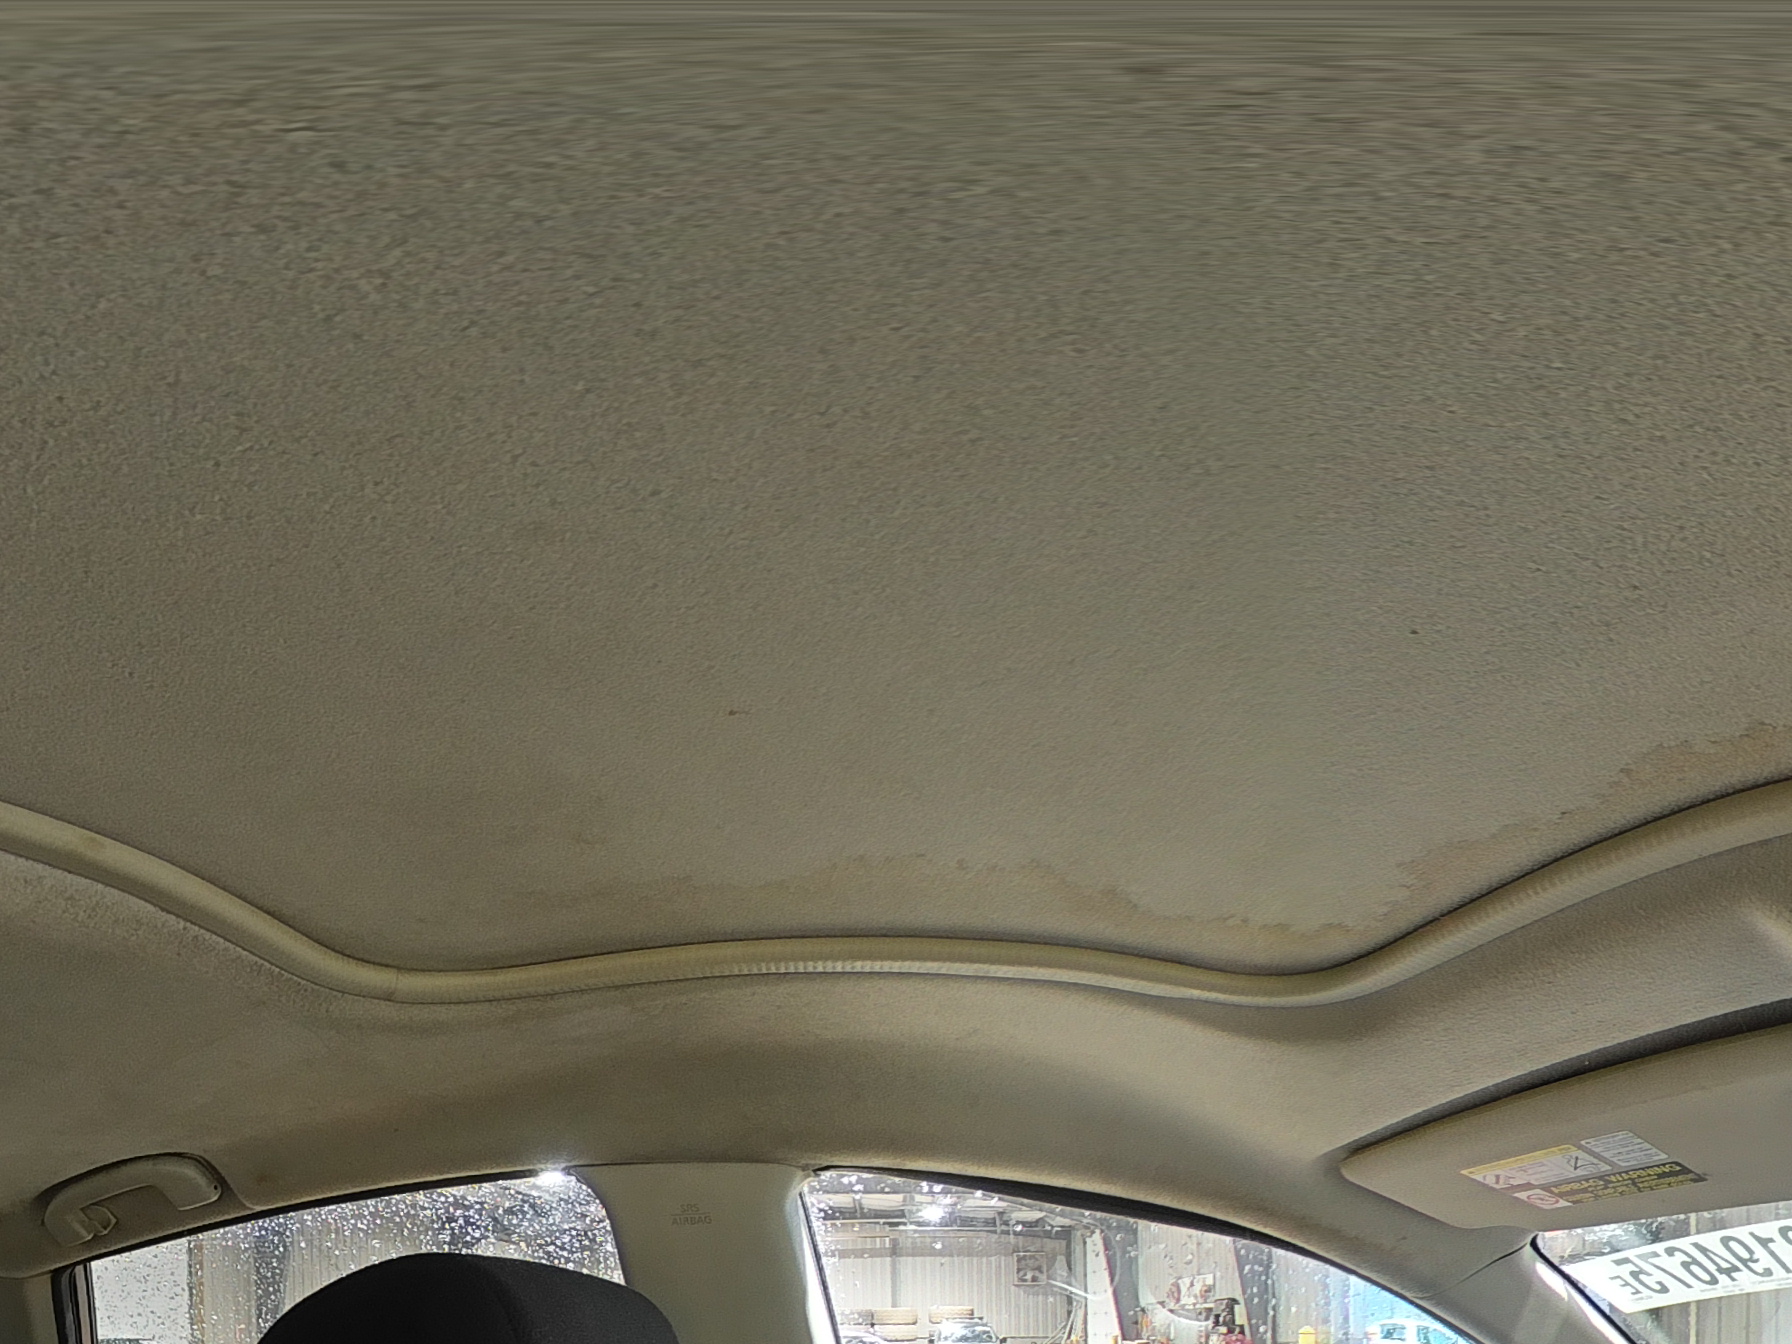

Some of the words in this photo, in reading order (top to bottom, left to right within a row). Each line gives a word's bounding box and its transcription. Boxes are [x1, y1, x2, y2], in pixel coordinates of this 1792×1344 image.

[1551, 1178, 1605, 1194] AIRBAG
[1605, 1163, 1683, 1183] WARNING
[680, 1203, 700, 1213] SRS
[671, 1215, 713, 1226] AIRBAG
